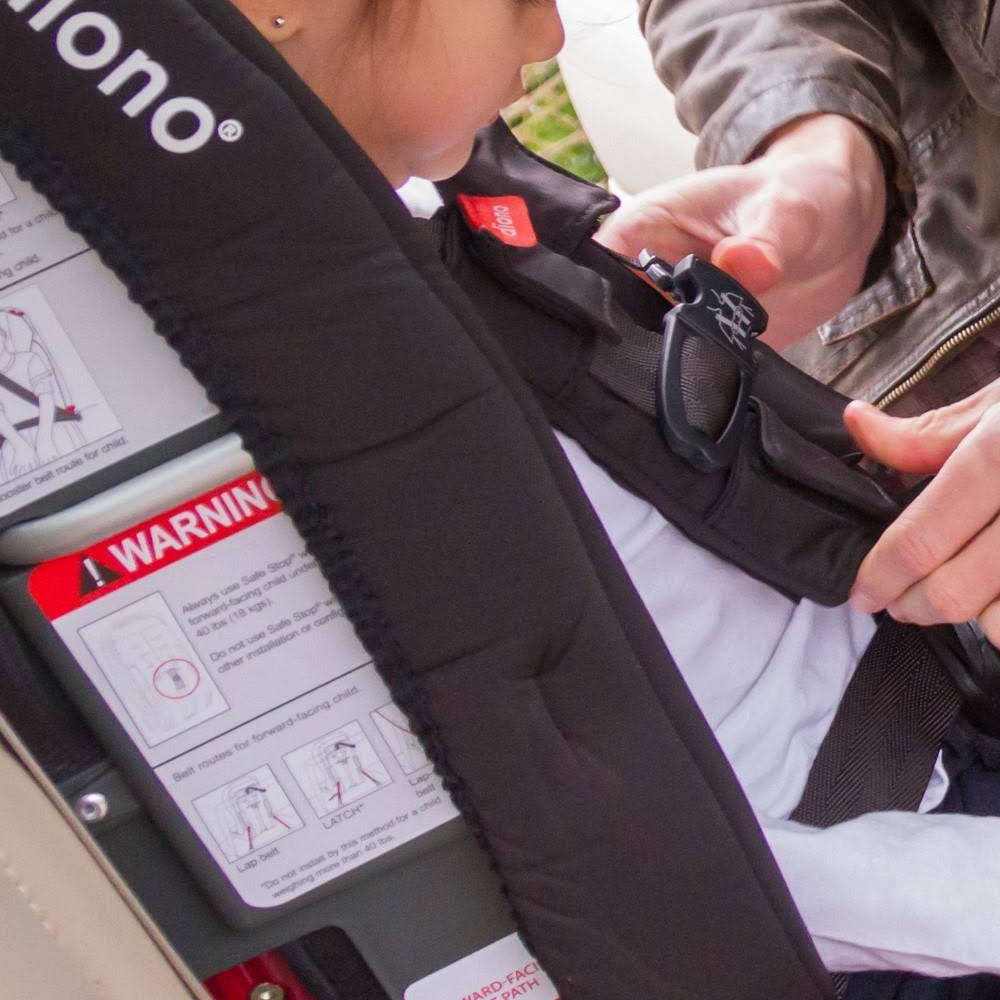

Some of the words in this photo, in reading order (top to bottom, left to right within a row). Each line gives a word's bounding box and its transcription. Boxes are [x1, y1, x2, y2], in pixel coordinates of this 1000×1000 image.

[492, 205, 517, 237] diono
[0, 481, 32, 500] ooster
[182, 591, 220, 614] Always
[220, 582, 241, 596] use
[241, 569, 266, 585] Safe
[188, 586, 262, 626] forward-facing
[263, 574, 287, 591] child
[196, 626, 211, 638] 40
[212, 616, 228, 631] lbs
[210, 649, 227, 662] Do
[228, 638, 246, 653] not
[247, 630, 266, 645] use
[266, 618, 292, 635] Safe
[217, 656, 244, 674] other
[246, 629, 300, 662] installation
[301, 622, 313, 634] or
[172, 765, 196, 783] Belt
[198, 749, 233, 770] routes
[234, 738, 251, 753] for
[252, 700, 331, 744] forward-facing
[236, 857, 258, 873] Lap
[259, 847, 281, 863] belt
[281, 867, 298, 881] not
[299, 853, 327, 873] install
[327, 848, 340, 860] by
[340, 837, 360, 852] this
[359, 819, 395, 843] method
[395, 812, 410, 827] for
[271, 872, 315, 899] weighing
[315, 861, 341, 879] more
[341, 849, 365, 867] than
[364, 840, 378, 854] 40
[502, 978, 540, 1000] PATH
